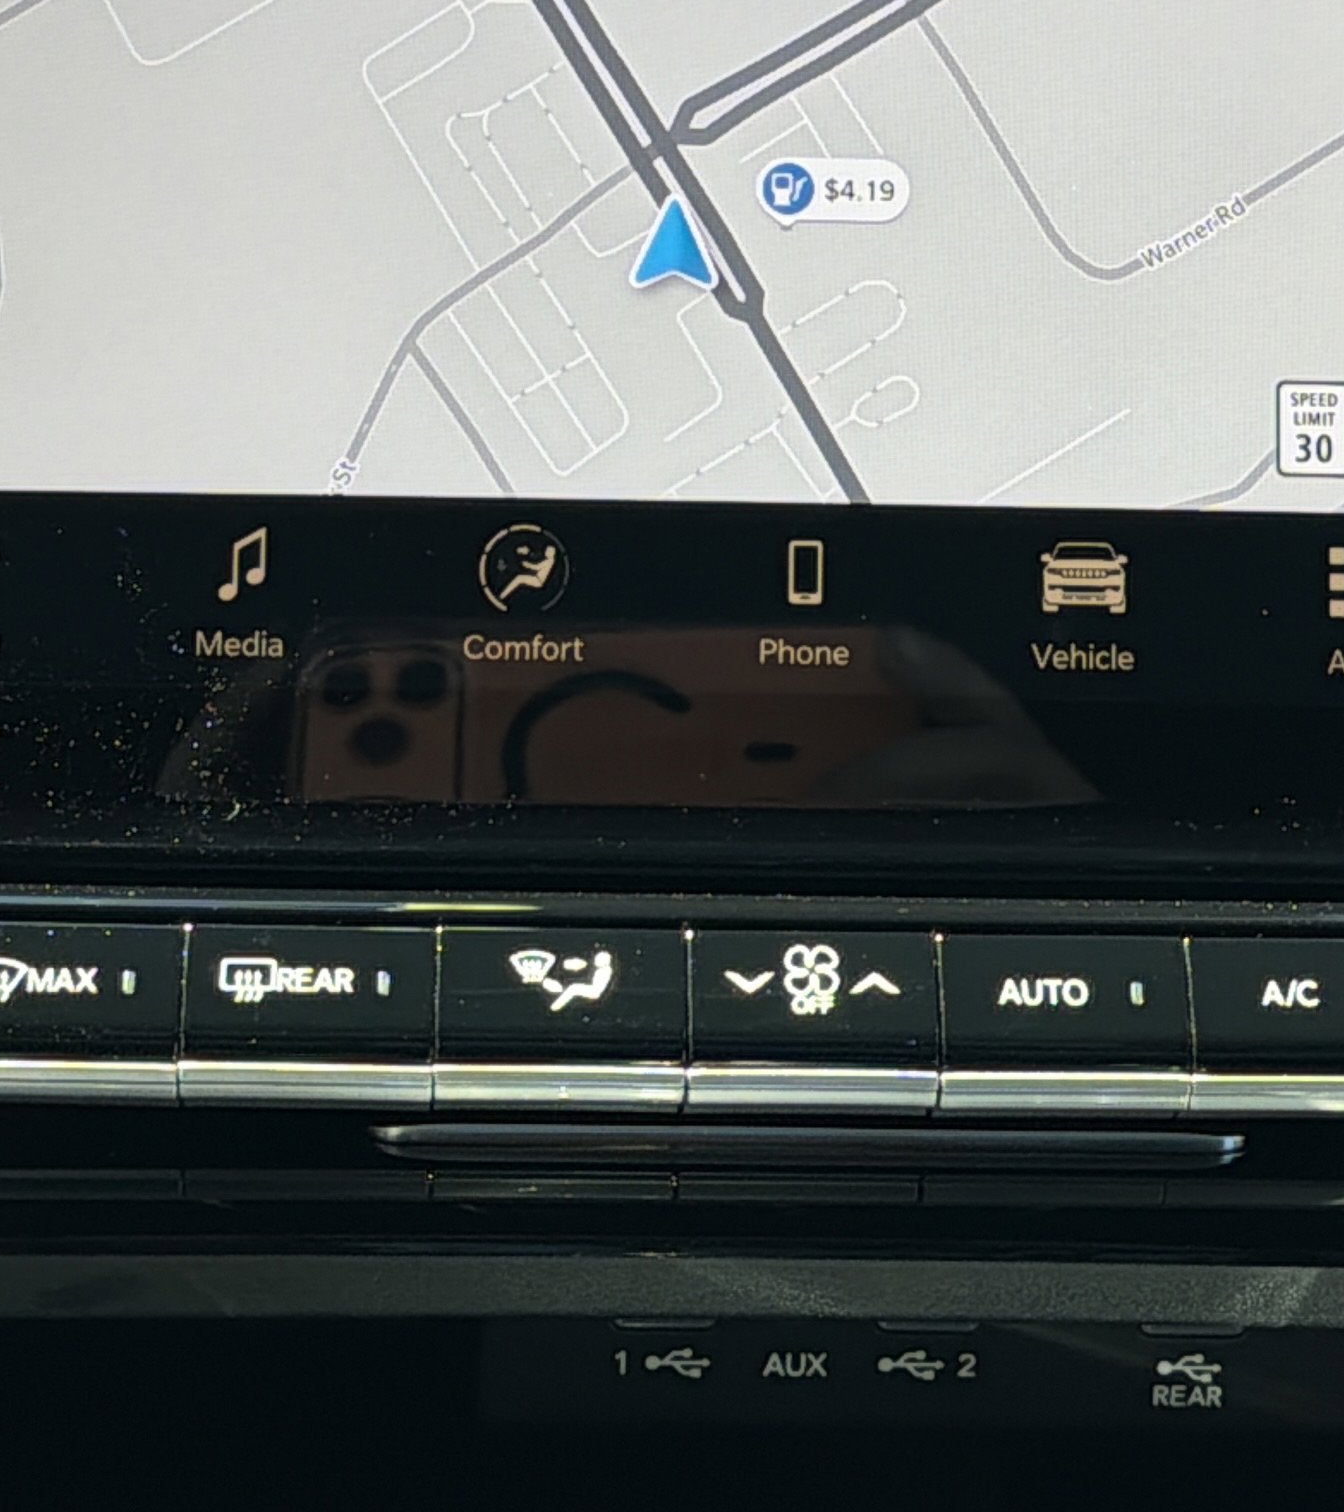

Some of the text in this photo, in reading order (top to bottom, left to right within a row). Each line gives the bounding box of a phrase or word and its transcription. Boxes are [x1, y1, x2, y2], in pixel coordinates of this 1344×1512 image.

[824, 177, 895, 203] $4.19
[1140, 195, 1247, 267] Warner Rd
[1289, 392, 1339, 408] SPEED
[1293, 411, 1336, 427] LIMIT
[1295, 433, 1333, 463] 30
[195, 630, 284, 658] Media
[463, 633, 585, 662] Comfort
[759, 638, 850, 666] Phone
[1030, 642, 1135, 671] Vehicle
[26, 967, 98, 994] MAX
[277, 966, 355, 993] REAR
[997, 977, 1090, 1007] AUTO
[1261, 978, 1321, 1008] A/C
[790, 994, 835, 1015] OFF
[614, 1350, 628, 1376] 1
[762, 1352, 827, 1378] AUX
[957, 1353, 977, 1378] 2
[1152, 1384, 1223, 1408] REAR
